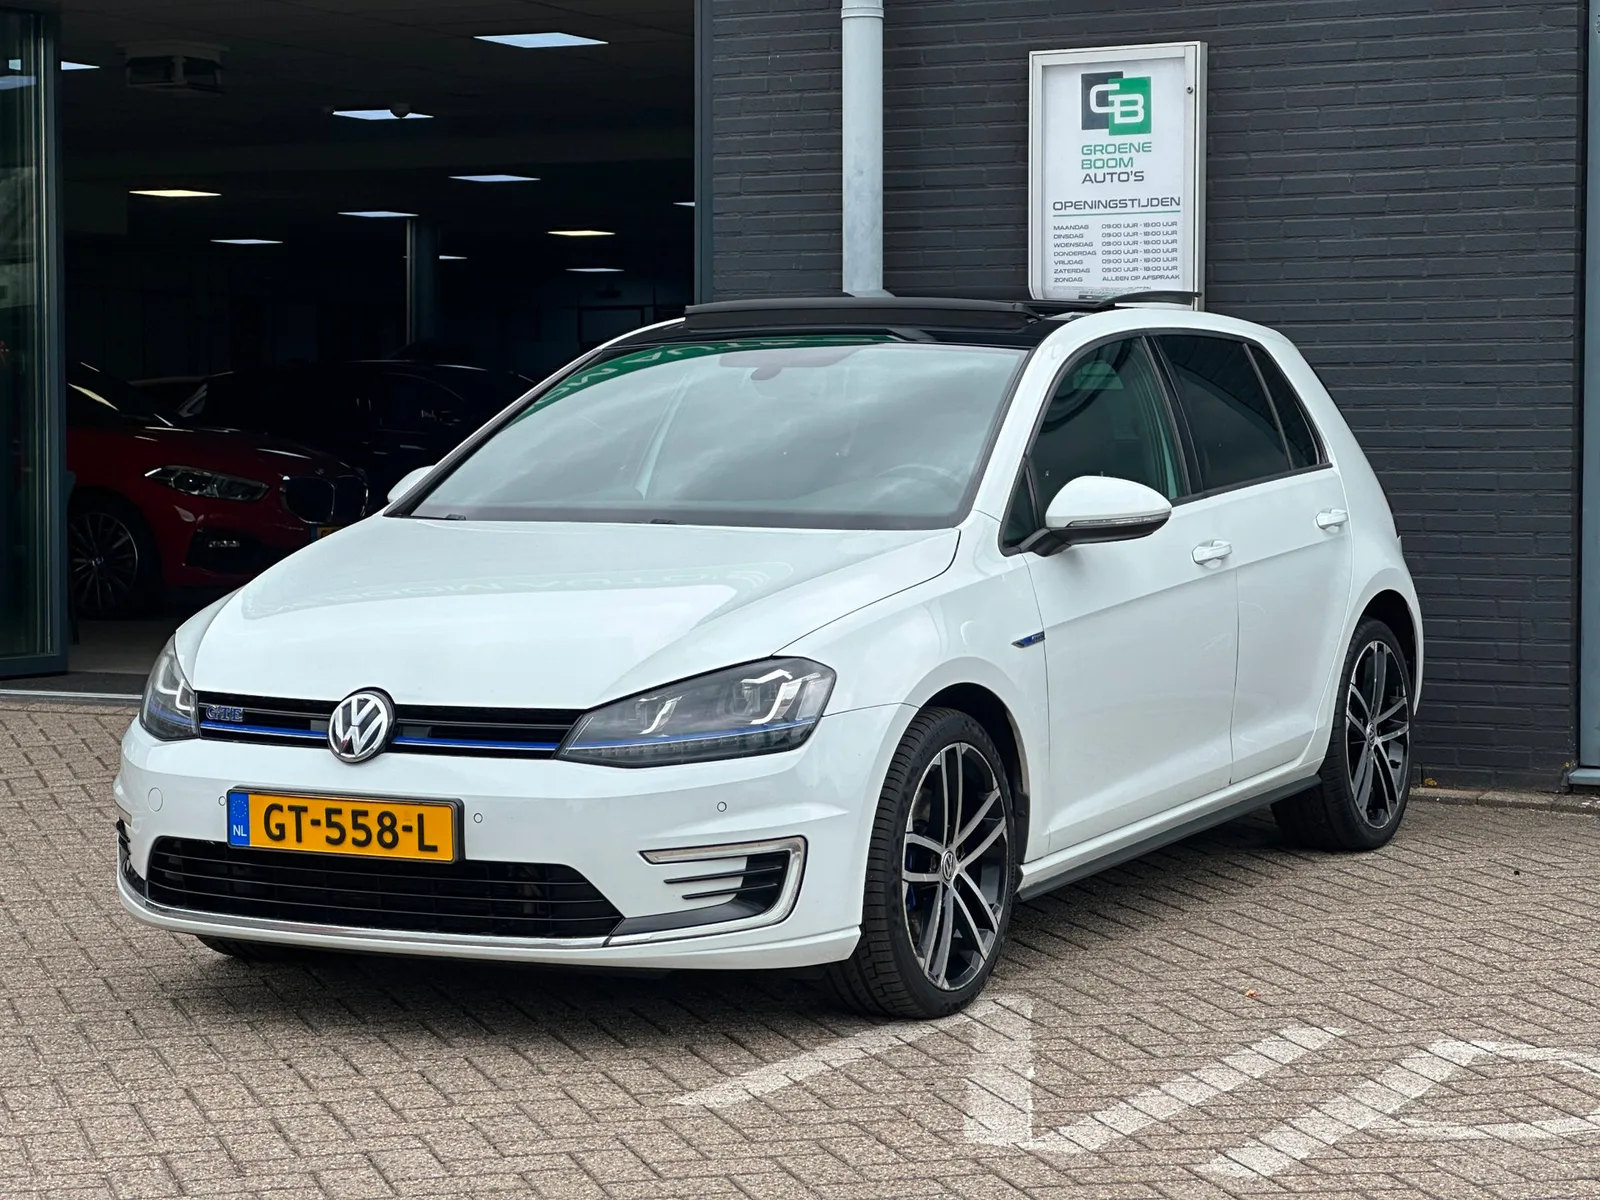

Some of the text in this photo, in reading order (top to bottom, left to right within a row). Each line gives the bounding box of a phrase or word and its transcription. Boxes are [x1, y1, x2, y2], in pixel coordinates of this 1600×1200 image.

[1081, 142, 1152, 155] GROENE
[1081, 157, 1133, 170] BOOM
[1081, 171, 1145, 184] AUTO'S
[1053, 197, 1181, 211] OPENINGSTIJDEN
[206, 704, 244, 722] GTE
[232, 803, 438, 852] NL GT-558-L
